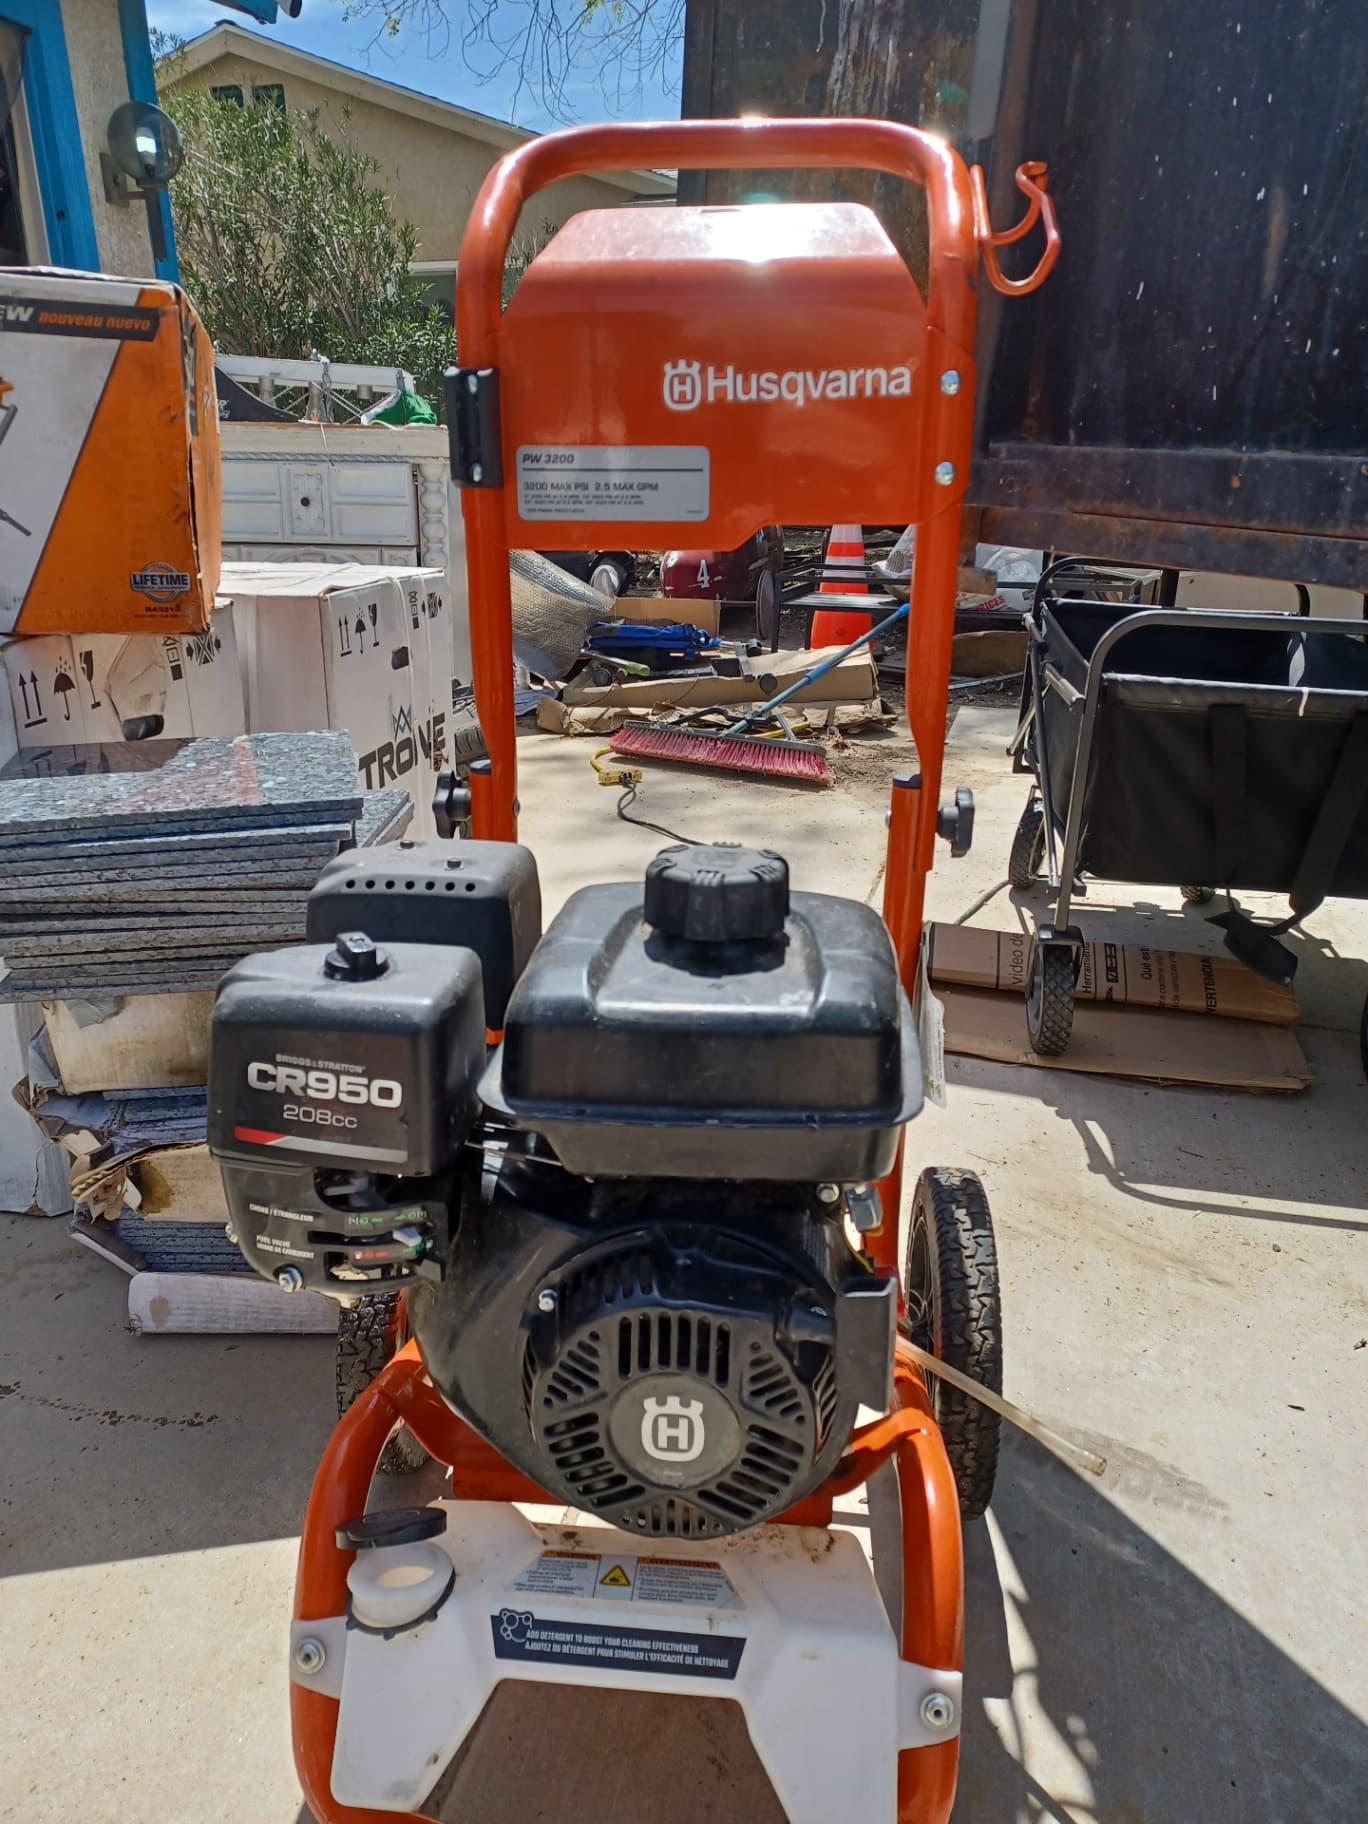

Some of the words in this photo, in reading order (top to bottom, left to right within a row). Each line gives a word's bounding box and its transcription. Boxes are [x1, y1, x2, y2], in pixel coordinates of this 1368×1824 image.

[38, 311, 104, 328] nouveau
[105, 317, 152, 331] nuevo
[706, 365, 912, 407] Husqvarna
[521, 453, 543, 465] PW
[543, 453, 575, 465] 3200
[522, 481, 548, 492] 3200
[550, 481, 572, 492] MAX
[574, 481, 590, 492] PSI
[612, 481, 635, 492] MAX
[131, 573, 190, 586] LIFETIME
[696, 559, 711, 589] 4
[1008, 948, 1025, 985] video
[247, 1061, 403, 1109] CR950
[282, 1104, 359, 1129] 208cc
[540, 1631, 574, 1642] DETERGENT
[575, 1634, 583, 1643] TO
[604, 1636, 621, 1647] YOUR
[621, 1638, 652, 1650] CLEANING
[652, 1640, 699, 1654] EFFECTIVENESS
